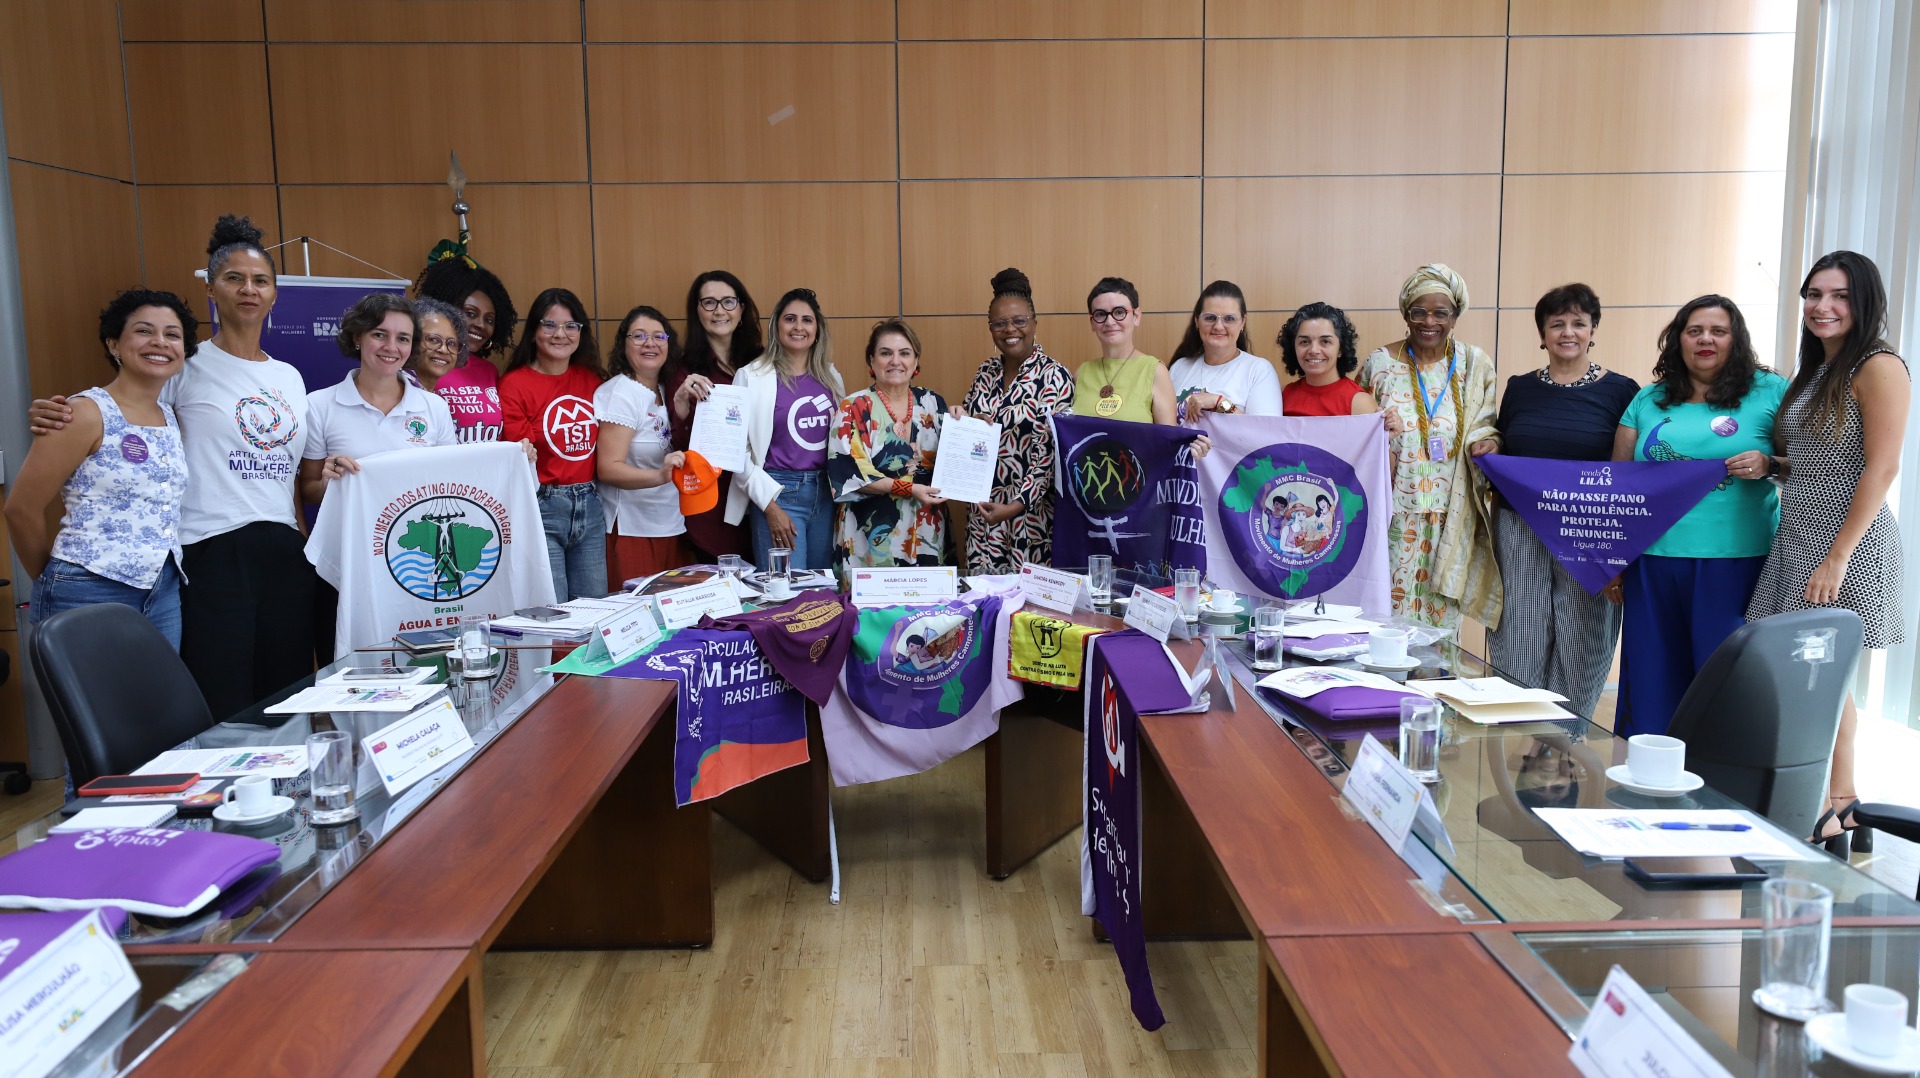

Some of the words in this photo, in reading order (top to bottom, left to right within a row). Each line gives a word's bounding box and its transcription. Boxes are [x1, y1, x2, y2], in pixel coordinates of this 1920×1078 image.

[458, 385, 483, 395] SER
[457, 405, 484, 414] VOU
[798, 415, 828, 429] CUT
[565, 441, 592, 453] BRASIL
[1581, 469, 1602, 477] tenda
[1275, 474, 1295, 486] MMC
[1296, 474, 1322, 485] Brasil
[1580, 475, 1613, 486] LILÁS
[1542, 488, 1569, 501] NÃO
[1569, 492, 1609, 502] PASSE
[1610, 493, 1646, 504] PANO
[1537, 501, 1568, 513] PARA
[1569, 504, 1578, 513] A
[1579, 503, 1652, 517] VIOLÊNCIA.
[373, 502, 400, 556] MOVIMENTO
[396, 490, 417, 508] DOS
[415, 482, 470, 500] ATINGIDOS
[468, 486, 488, 504] POR
[483, 496, 512, 545] BARRAGENS
[1561, 515, 1623, 528] PROTEJA.
[1559, 527, 1628, 541] DENUNCIE.
[1254, 518, 1273, 555] Movimento
[1273, 551, 1281, 561] de
[1281, 556, 1314, 566] Mulheres
[1313, 520, 1342, 560] Camponesas
[1573, 540, 1596, 550] Ligue
[1596, 541, 1613, 550] 180.
[1033, 574, 1048, 583] SANDRA
[433, 604, 464, 615] Brasil
[398, 619, 433, 632] ÁGUA
[435, 617, 443, 627] E
[446, 613, 497, 625] ENIA
[907, 610, 932, 623] MMC
[913, 675, 925, 683] de
[926, 660, 960, 683] Mulheres
[957, 614, 974, 661] Campones
[396, 733, 421, 751] MICHELA
[419, 721, 442, 738] CALAÇA
